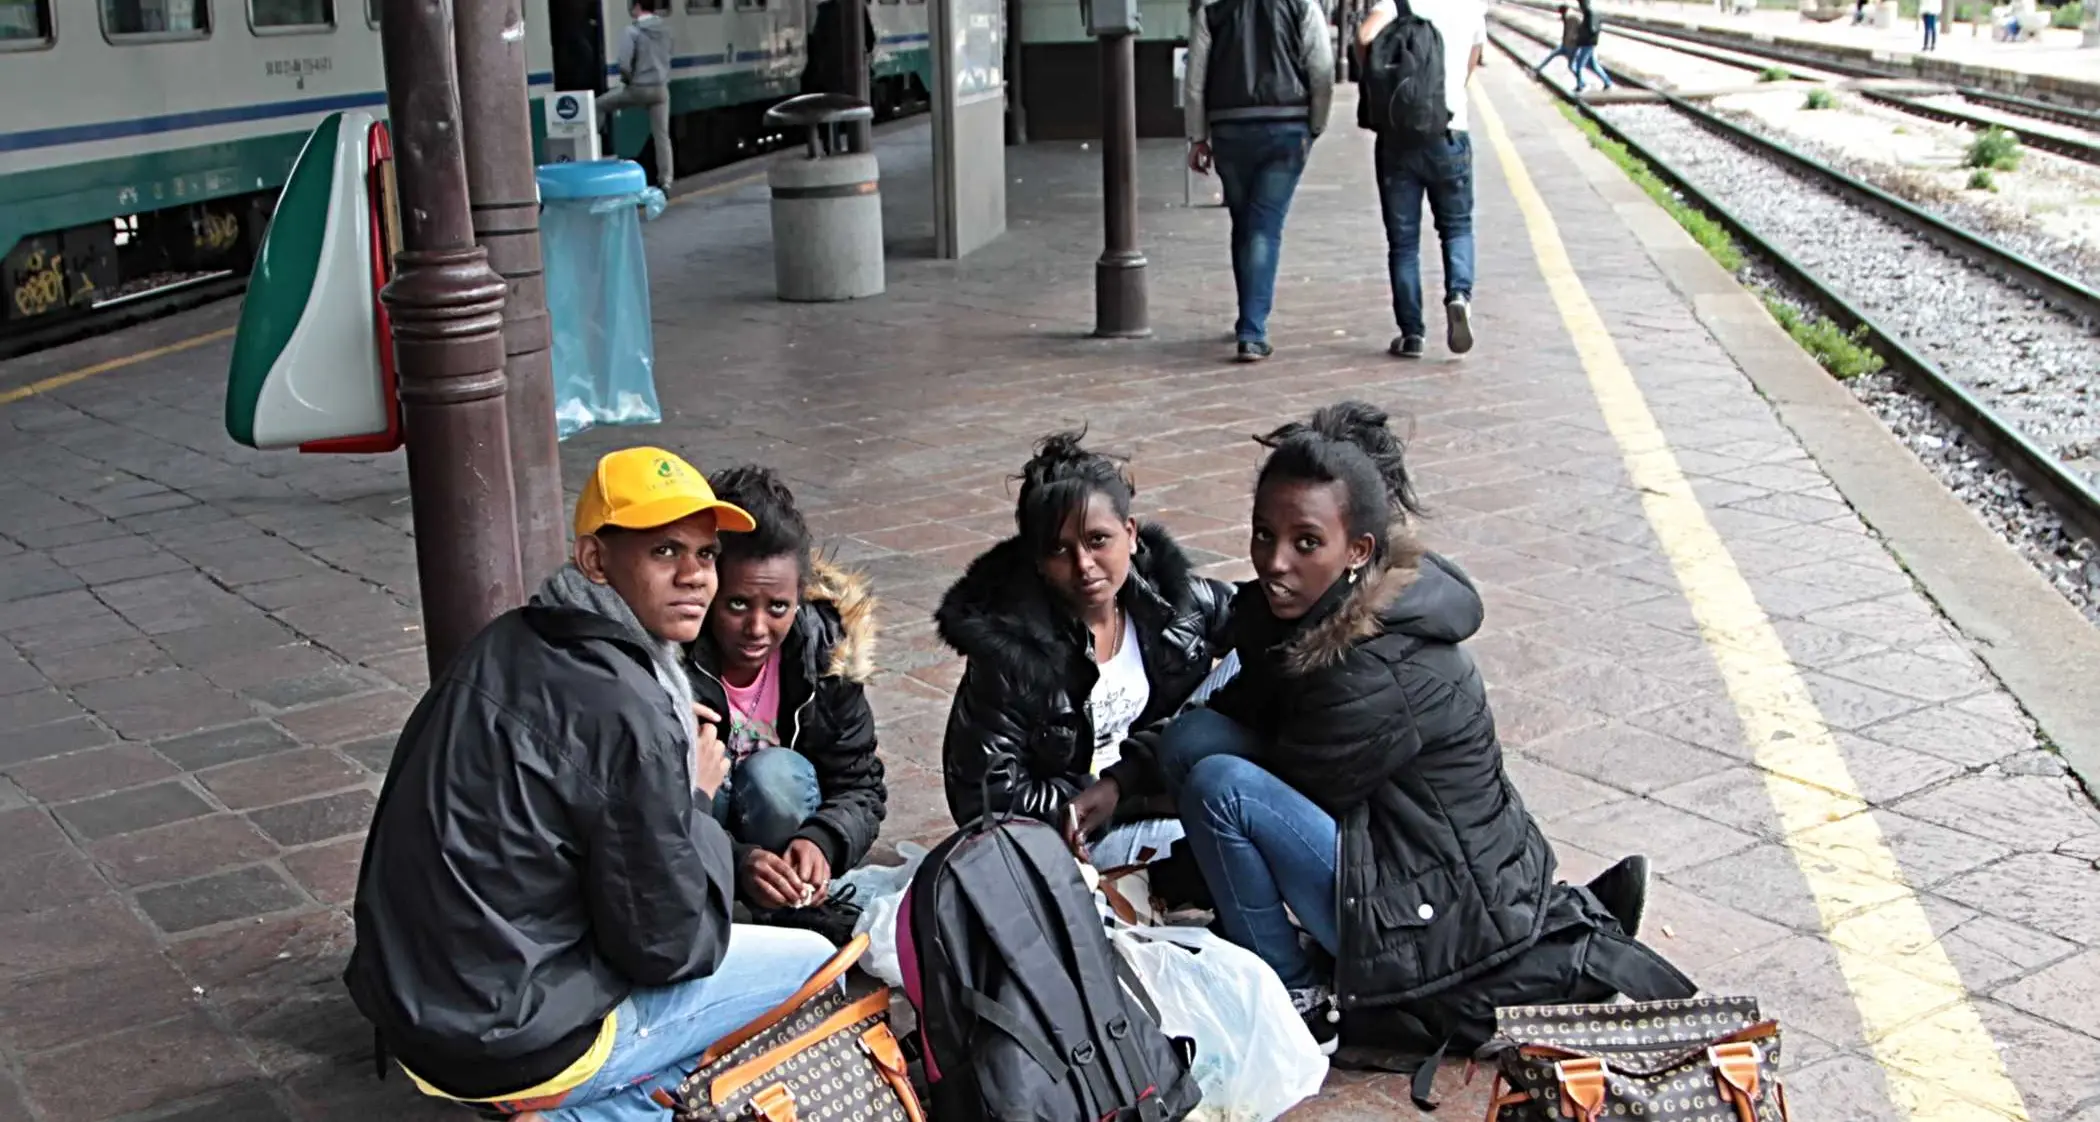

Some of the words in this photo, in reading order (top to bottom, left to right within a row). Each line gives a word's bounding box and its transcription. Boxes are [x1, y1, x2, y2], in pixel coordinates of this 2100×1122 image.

[808, 1047, 819, 1058] G
[808, 1067, 820, 1079] G
[832, 1077, 844, 1090] G
[852, 1064, 865, 1077] G
[1525, 1068, 1537, 1080] G
[1672, 1079, 1685, 1091] G
[1544, 1087, 1556, 1099] G
[832, 1099, 844, 1112] G
[852, 1087, 865, 1100] G
[873, 1098, 883, 1111] G
[1631, 1101, 1643, 1114] G
[1663, 1099, 1675, 1112] G
[1694, 1096, 1705, 1109] G
